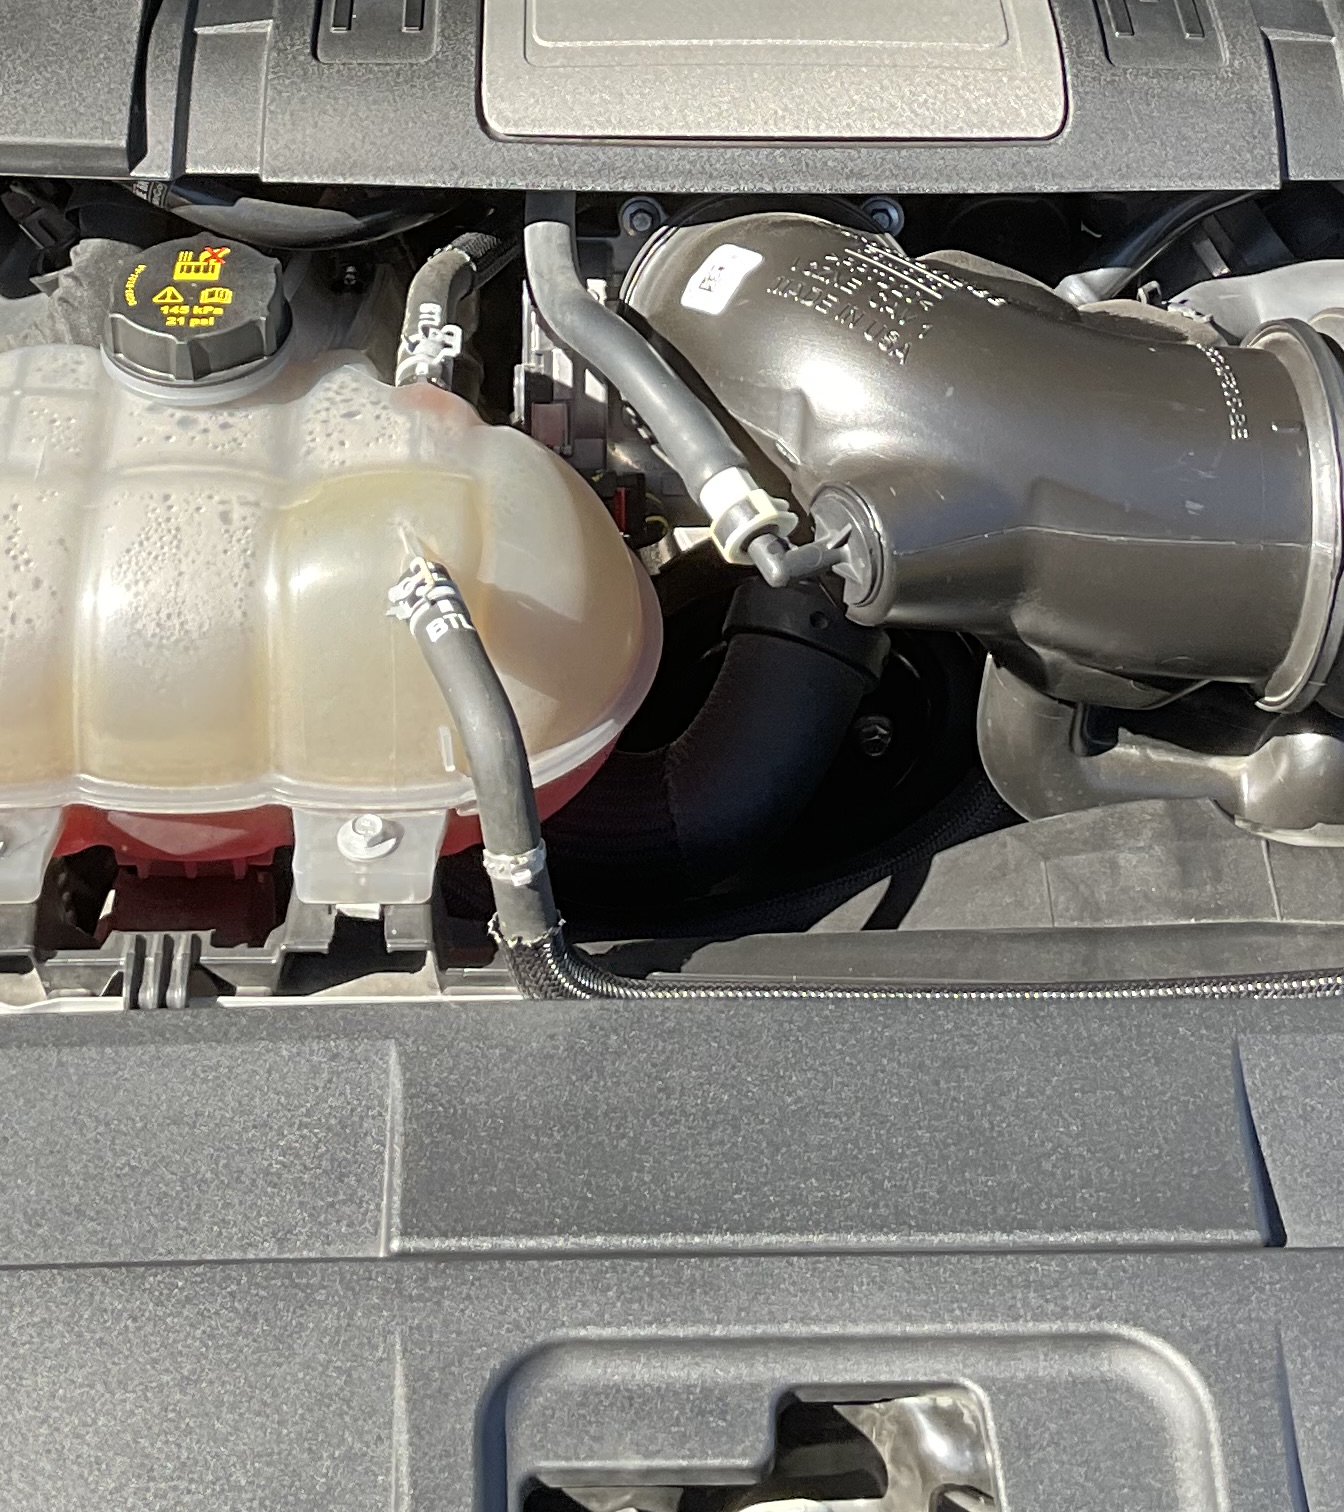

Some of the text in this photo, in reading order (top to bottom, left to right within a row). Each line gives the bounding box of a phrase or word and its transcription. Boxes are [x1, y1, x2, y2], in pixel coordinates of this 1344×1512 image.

[160, 305, 224, 315] 145 kPa
[165, 316, 186, 326] 21
[766, 276, 840, 315] MADE
[834, 303, 865, 330] IN
[863, 319, 913, 365] USA
